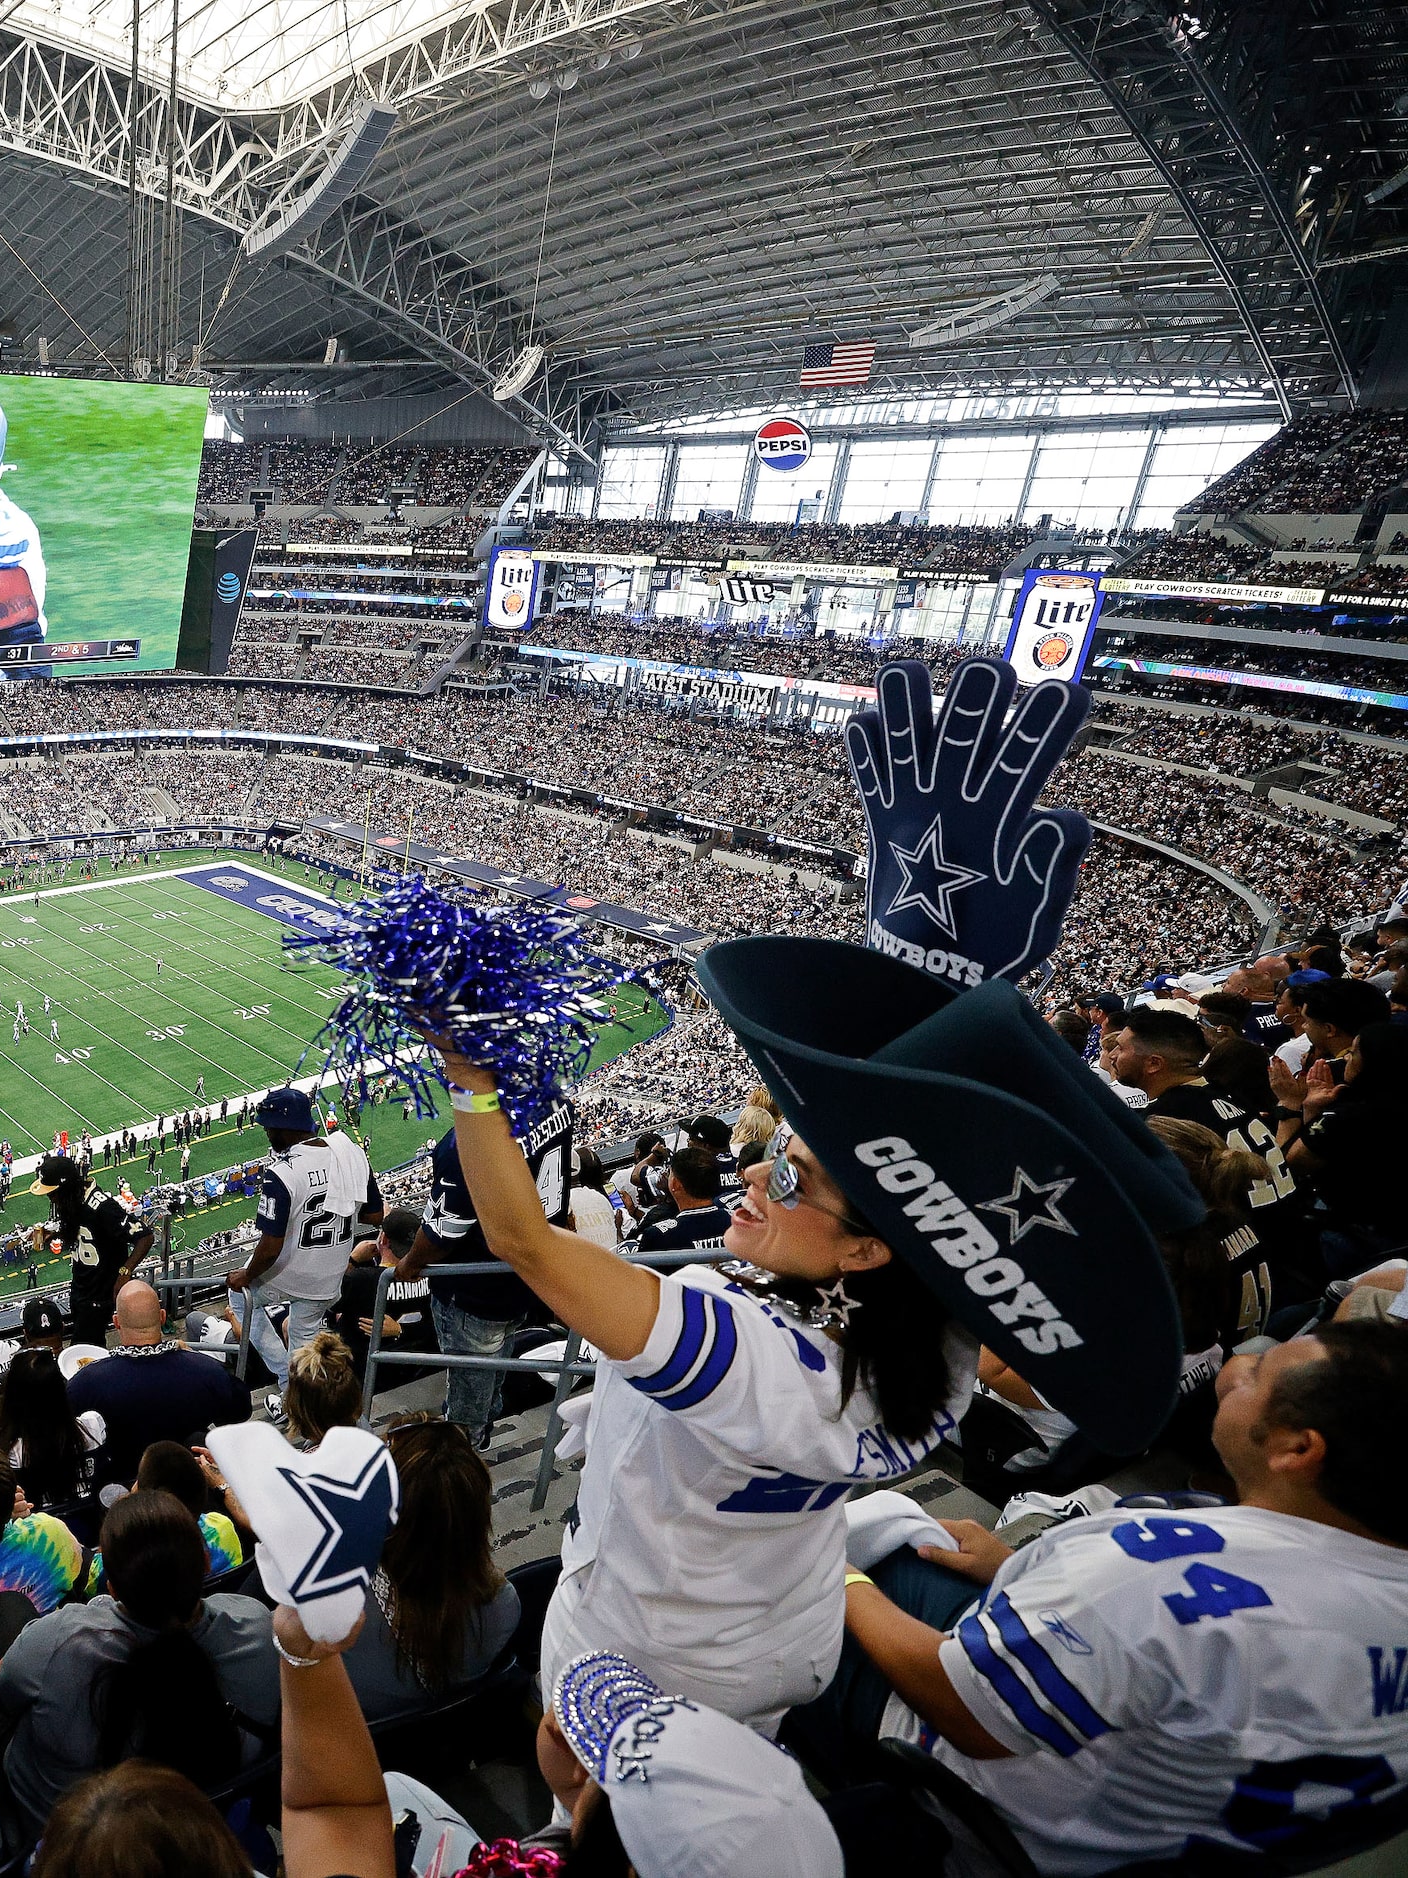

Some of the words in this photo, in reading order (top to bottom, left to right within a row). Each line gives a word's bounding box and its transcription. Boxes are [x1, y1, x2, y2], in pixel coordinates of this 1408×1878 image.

[758, 440, 807, 451] PEPSI
[500, 566, 532, 588] Lite
[652, 571, 669, 579] GREAT
[769, 564, 803, 572] COWBOYS
[804, 566, 835, 574] SCRATCH
[836, 567, 867, 576] TICKETS!
[903, 570, 920, 578] PLAY
[940, 572, 958, 580] SHOT
[967, 573, 990, 582] $100K
[651, 578, 667, 586] TASTE
[898, 585, 910, 594] LESS
[1104, 583, 1130, 591] LOTTERY
[1134, 583, 1155, 591] PLAY
[1156, 584, 1203, 594] COWBOYS
[1204, 586, 1243, 597] SCRATCH
[1244, 588, 1283, 599] TICKETS!
[718, 578, 775, 607] Lite
[896, 593, 914, 603] FILLING
[1286, 594, 1317, 603] LOTTERY
[1329, 594, 1347, 603] PLAY
[1346, 595, 1363, 605] FOR
[1362, 597, 1370, 605] A
[1370, 597, 1390, 606] SHOT
[1389, 598, 1401, 607] AT
[1033, 598, 1091, 630] Lite
[50, 644, 69, 656] 2ND
[71, 644, 82, 655] &
[81, 644, 90, 656] 5
[644, 673, 688, 695] AT&T
[690, 680, 774, 708] STADIUM
[682, 814, 734, 832] Blockchain.com
[775, 836, 833, 856] Blockchain.com
[314, 985, 348, 1000] 10
[232, 1003, 269, 1021] 20
[145, 1023, 186, 1042] 30
[54, 1047, 91, 1065] 40
[1226, 1117, 1297, 1209] 12
[307, 1168, 329, 1188] ELL
[536, 1144, 564, 1220] 4
[257, 1193, 277, 1221] 21
[854, 1135, 1085, 1356] COWBOYS
[1220, 1224, 1260, 1261] AMARA
